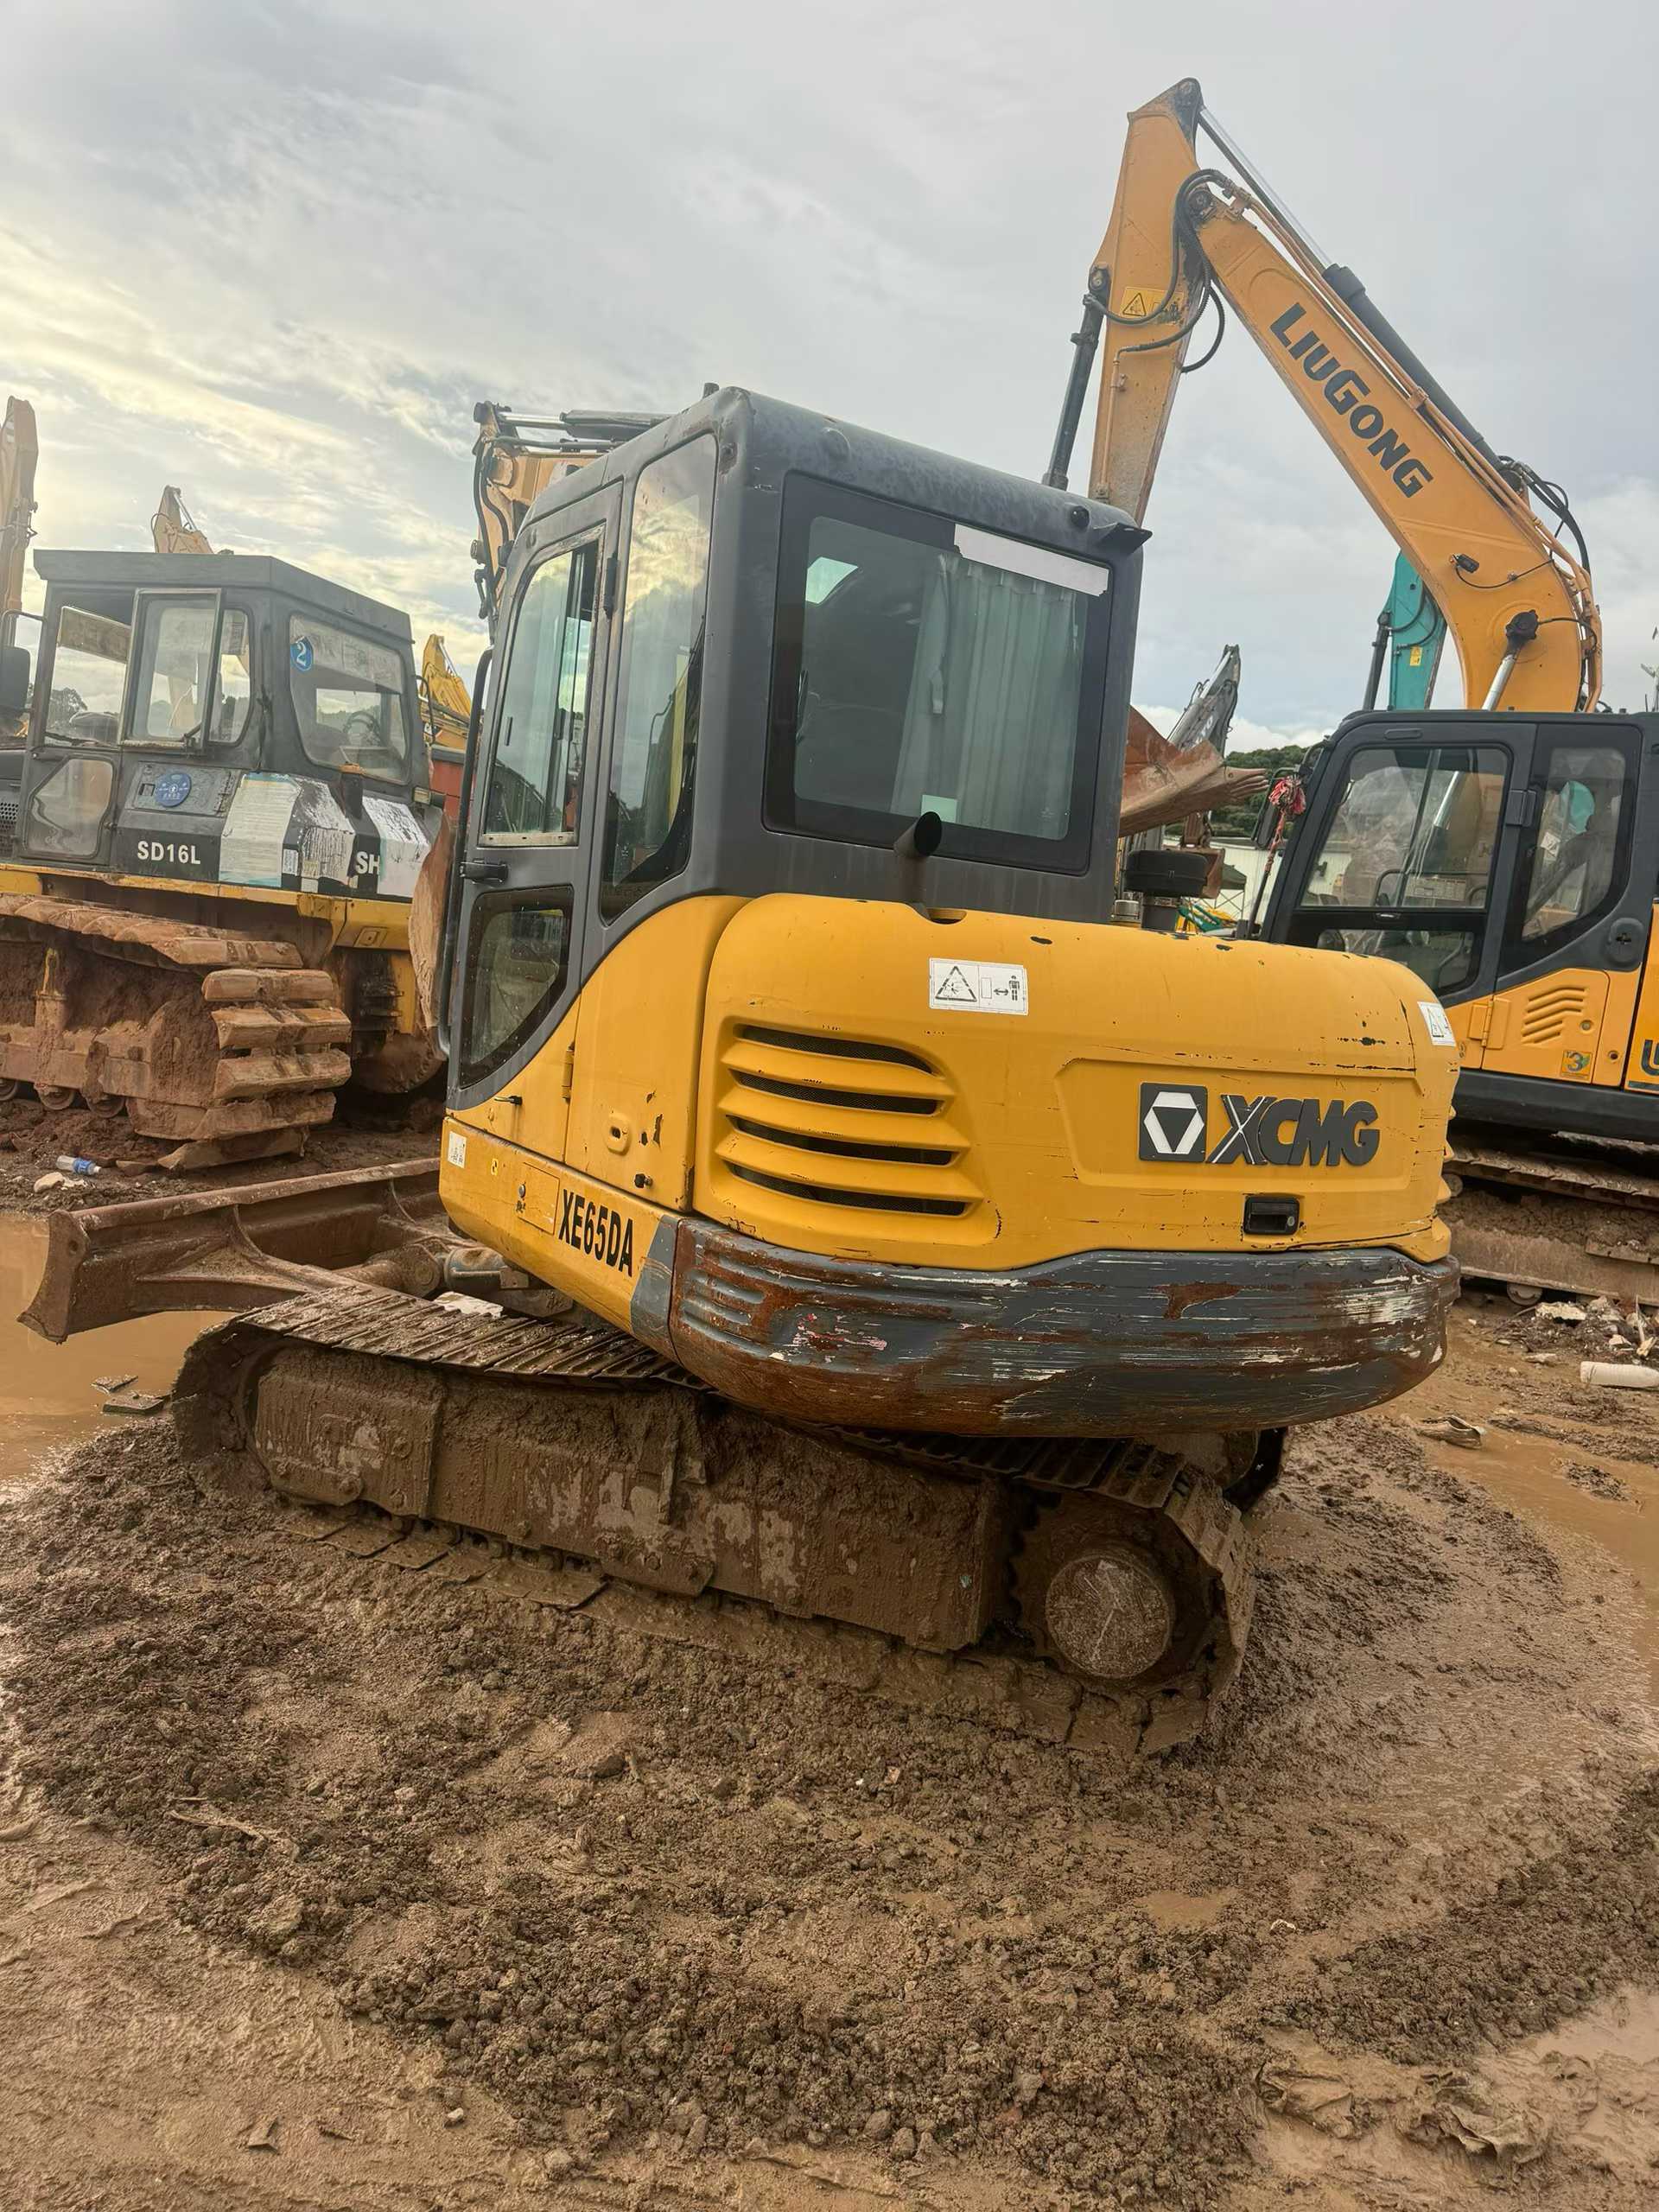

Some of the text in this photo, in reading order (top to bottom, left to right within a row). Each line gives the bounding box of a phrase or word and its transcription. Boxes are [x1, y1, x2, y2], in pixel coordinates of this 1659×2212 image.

[1270, 302, 1433, 499] LIUGONG
[296, 641, 307, 666] 2
[137, 841, 201, 865] SD16L
[1206, 1095, 1381, 1166] XCMG
[558, 1189, 633, 1278] XE65DA
